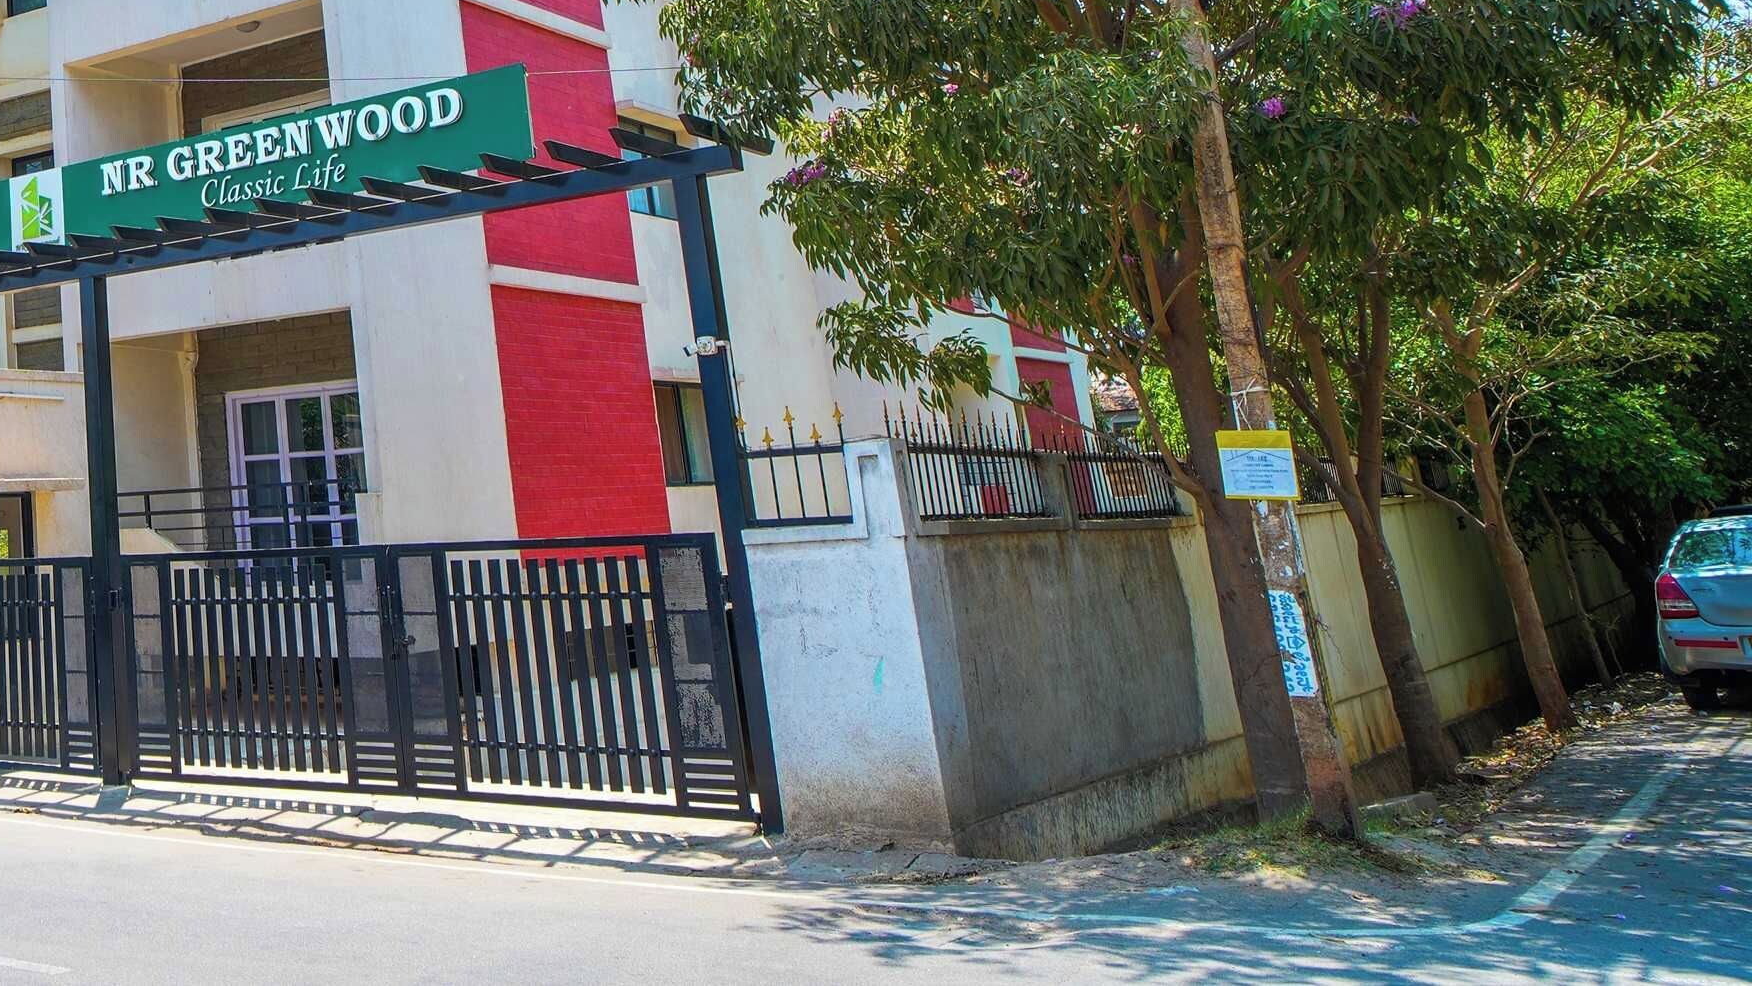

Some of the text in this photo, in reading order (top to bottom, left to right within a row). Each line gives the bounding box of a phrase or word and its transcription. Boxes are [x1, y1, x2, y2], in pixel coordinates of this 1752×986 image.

[100, 155, 158, 196] NR
[201, 153, 345, 207] Classic Life
